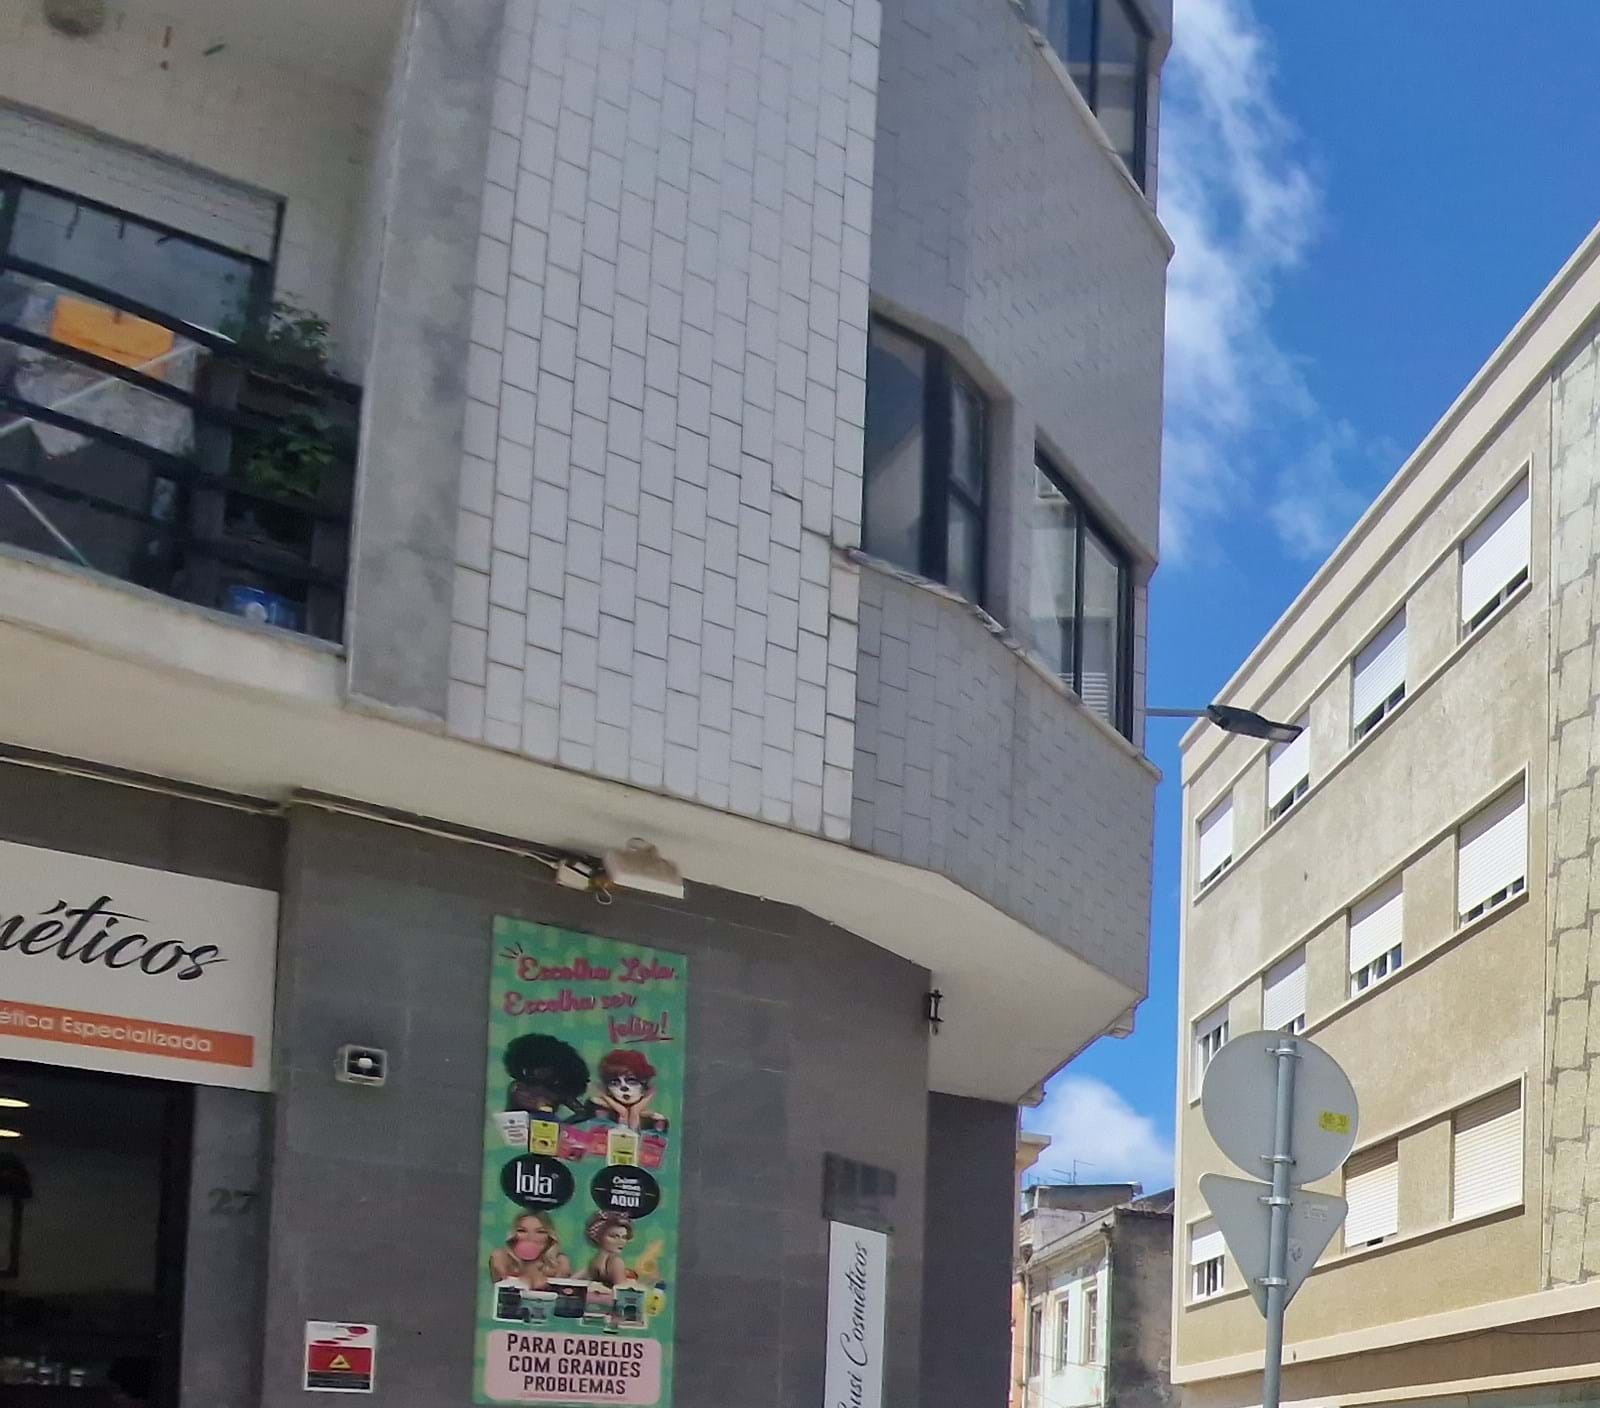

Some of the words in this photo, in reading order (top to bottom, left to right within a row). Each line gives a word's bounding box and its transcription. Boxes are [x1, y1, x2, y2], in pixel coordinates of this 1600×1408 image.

[62, 1015, 213, 1052] Especializada
[515, 1160, 553, 1196] lola
[839, 1239, 868, 1367] Cosméticos
[506, 1332, 556, 1354] PARA
[563, 1338, 644, 1360] CABELOS
[508, 1354, 550, 1374] COM
[557, 1357, 641, 1378] GRANDES
[523, 1375, 627, 1395] PROBLEMAS
